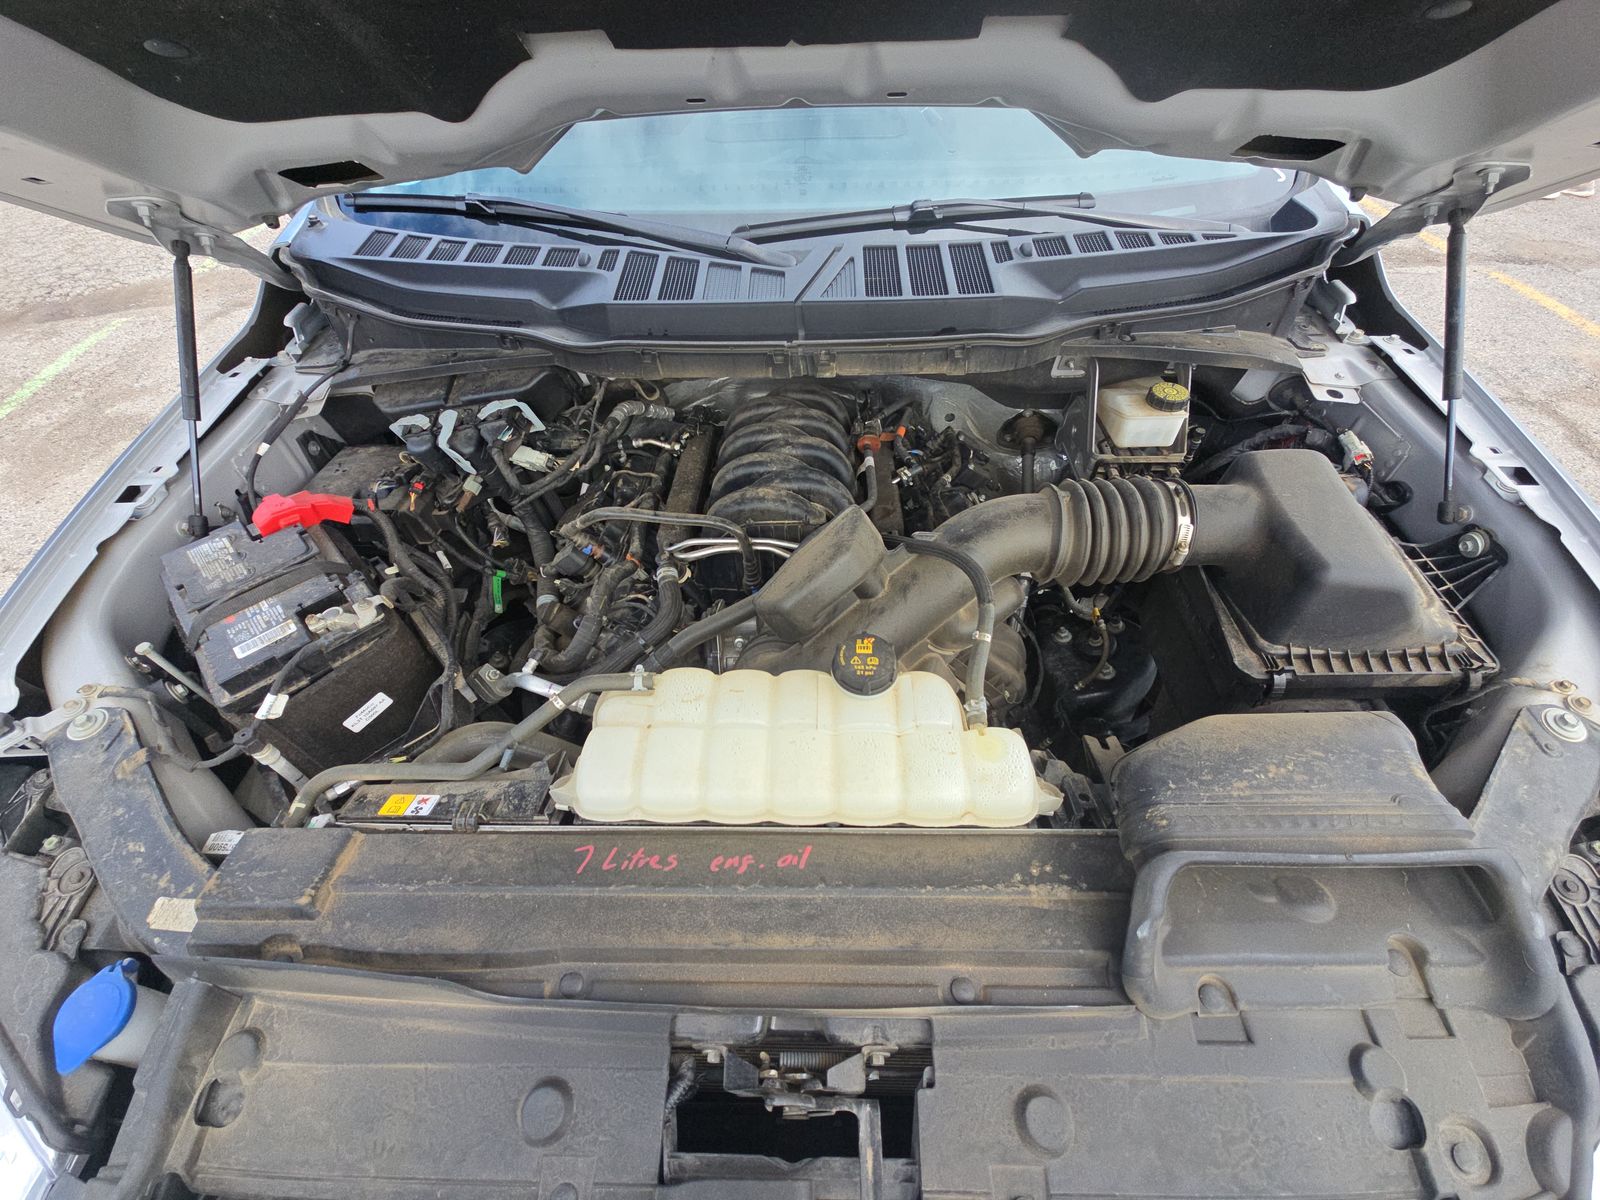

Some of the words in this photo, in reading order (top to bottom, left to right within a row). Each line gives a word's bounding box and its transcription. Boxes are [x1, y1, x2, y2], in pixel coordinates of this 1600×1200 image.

[574, 844, 595, 874] 7
[601, 846, 679, 872] Litres
[776, 844, 813, 871] oil
